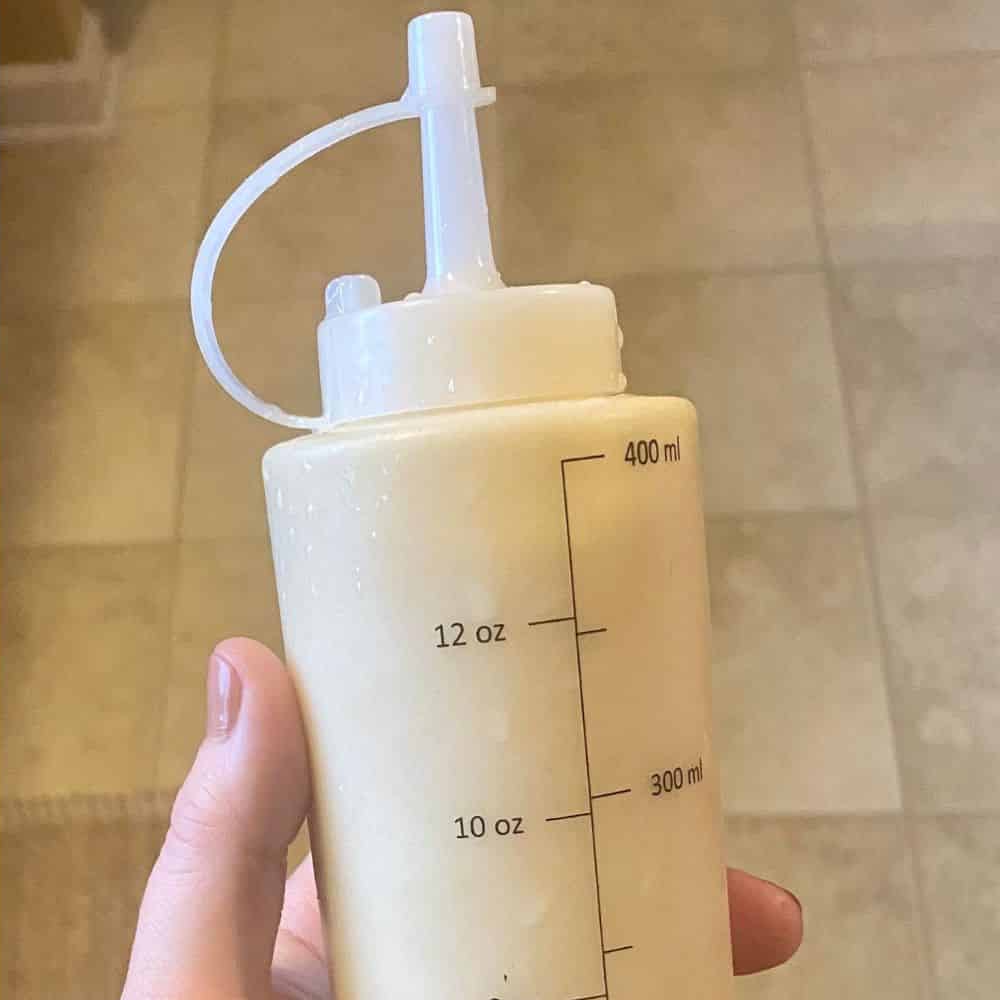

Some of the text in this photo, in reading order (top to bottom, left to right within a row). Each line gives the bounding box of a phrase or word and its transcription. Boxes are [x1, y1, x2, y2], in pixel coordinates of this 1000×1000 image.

[624, 436, 681, 467] 400 ml
[435, 622, 507, 649] 12 oz
[650, 757, 703, 797] 300 ml
[454, 815, 524, 839] 10 oz
